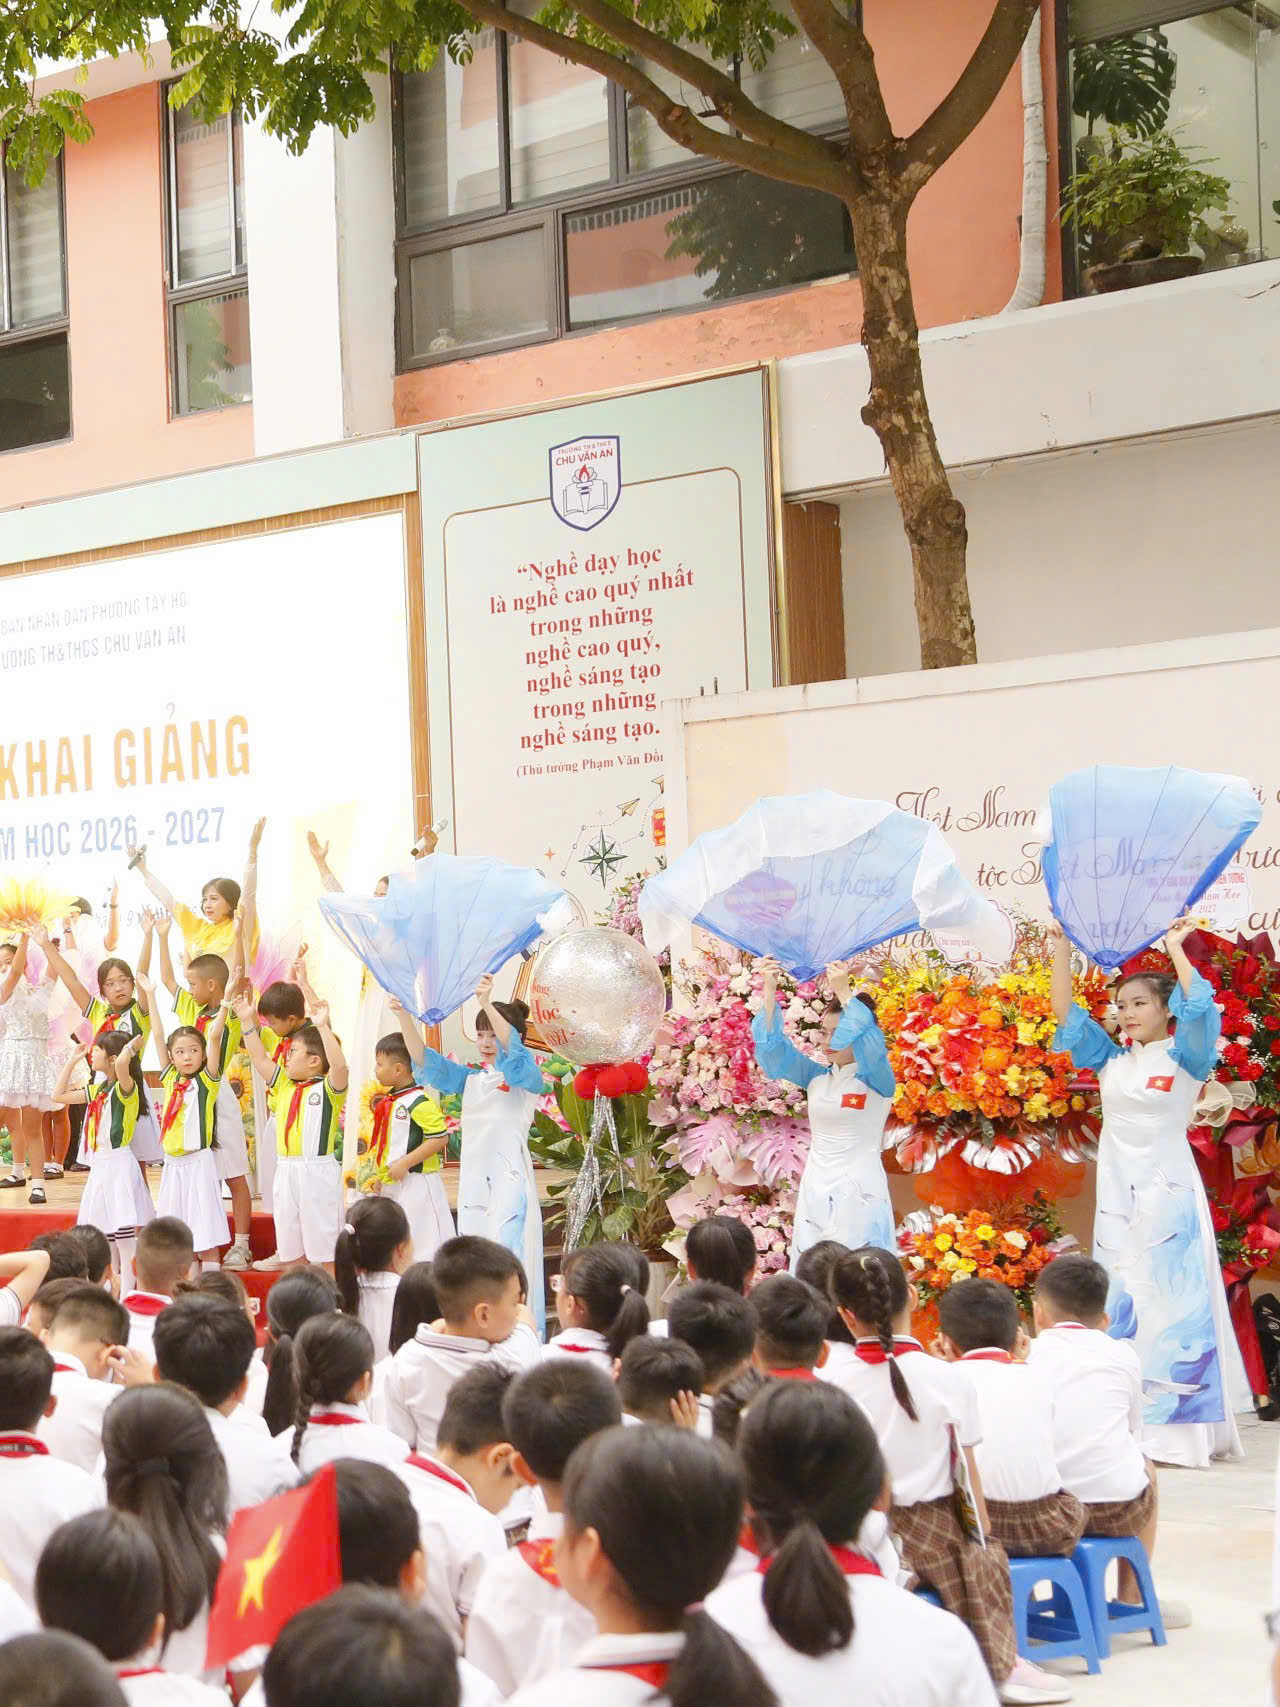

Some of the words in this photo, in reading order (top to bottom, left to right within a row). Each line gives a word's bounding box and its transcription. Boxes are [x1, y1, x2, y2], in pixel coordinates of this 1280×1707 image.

[556, 455, 576, 466] CHU
[578, 450, 598, 462] VĂN
[600, 448, 614, 459] AN
[517, 551, 578, 583] “Nghề
[584, 553, 620, 575] dạy
[627, 548, 662, 569] học
[490, 595, 506, 614] là
[513, 584, 558, 615] nghề
[565, 586, 598, 604] cao
[603, 575, 640, 602] quý
[648, 563, 694, 591] nhất
[530, 617, 582, 635] trong
[589, 606, 653, 628] những
[40, 637, 98, 665] TH&THCS
[104, 633, 131, 655] CHU
[168, 624, 186, 646] AN
[525, 637, 571, 668] nghề
[577, 641, 610, 658] cao
[617, 630, 660, 657] quý,
[527, 664, 572, 696] nghề
[579, 666, 624, 687] sáng
[630, 663, 661, 684] tạo
[533, 702, 585, 719] trong
[592, 691, 656, 711] những
[113, 702, 251, 789] GIẢNG
[521, 721, 566, 752] nghề
[572, 723, 617, 744] sáng
[624, 720, 660, 742] tạo.
[516, 763, 543, 778] (Thủ
[546, 761, 578, 773] tướng
[582, 758, 614, 771] Phạm
[617, 754, 640, 766] Văn
[644, 748, 664, 764] Đồ
[896, 787, 953, 832] Vt
[956, 785, 1037, 832] Nam
[25, 821, 72, 866] HỌC
[80, 814, 137, 854] 2026
[165, 807, 225, 847] 2027
[976, 863, 1009, 890] tộc
